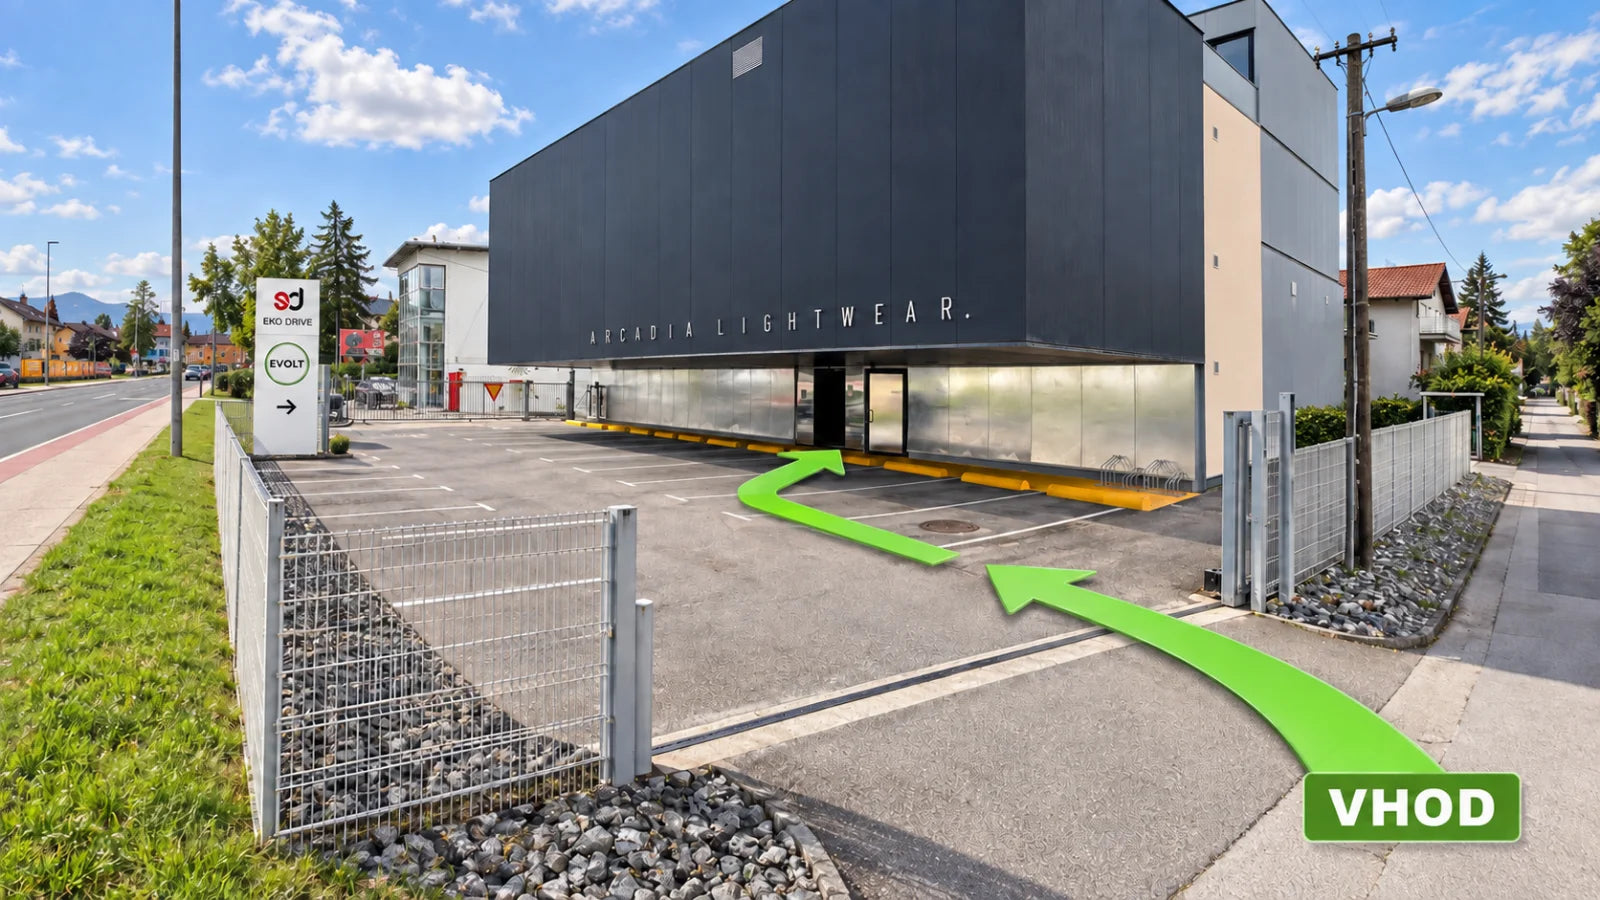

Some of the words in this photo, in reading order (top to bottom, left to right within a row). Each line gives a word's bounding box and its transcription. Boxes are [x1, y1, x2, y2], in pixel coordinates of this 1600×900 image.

[263, 317, 283, 326] EKO
[285, 317, 313, 326] DRIVE
[590, 322, 693, 345] ARCADIA
[717, 296, 971, 336] LIGHTWEAR.
[270, 359, 305, 368] EVOLT
